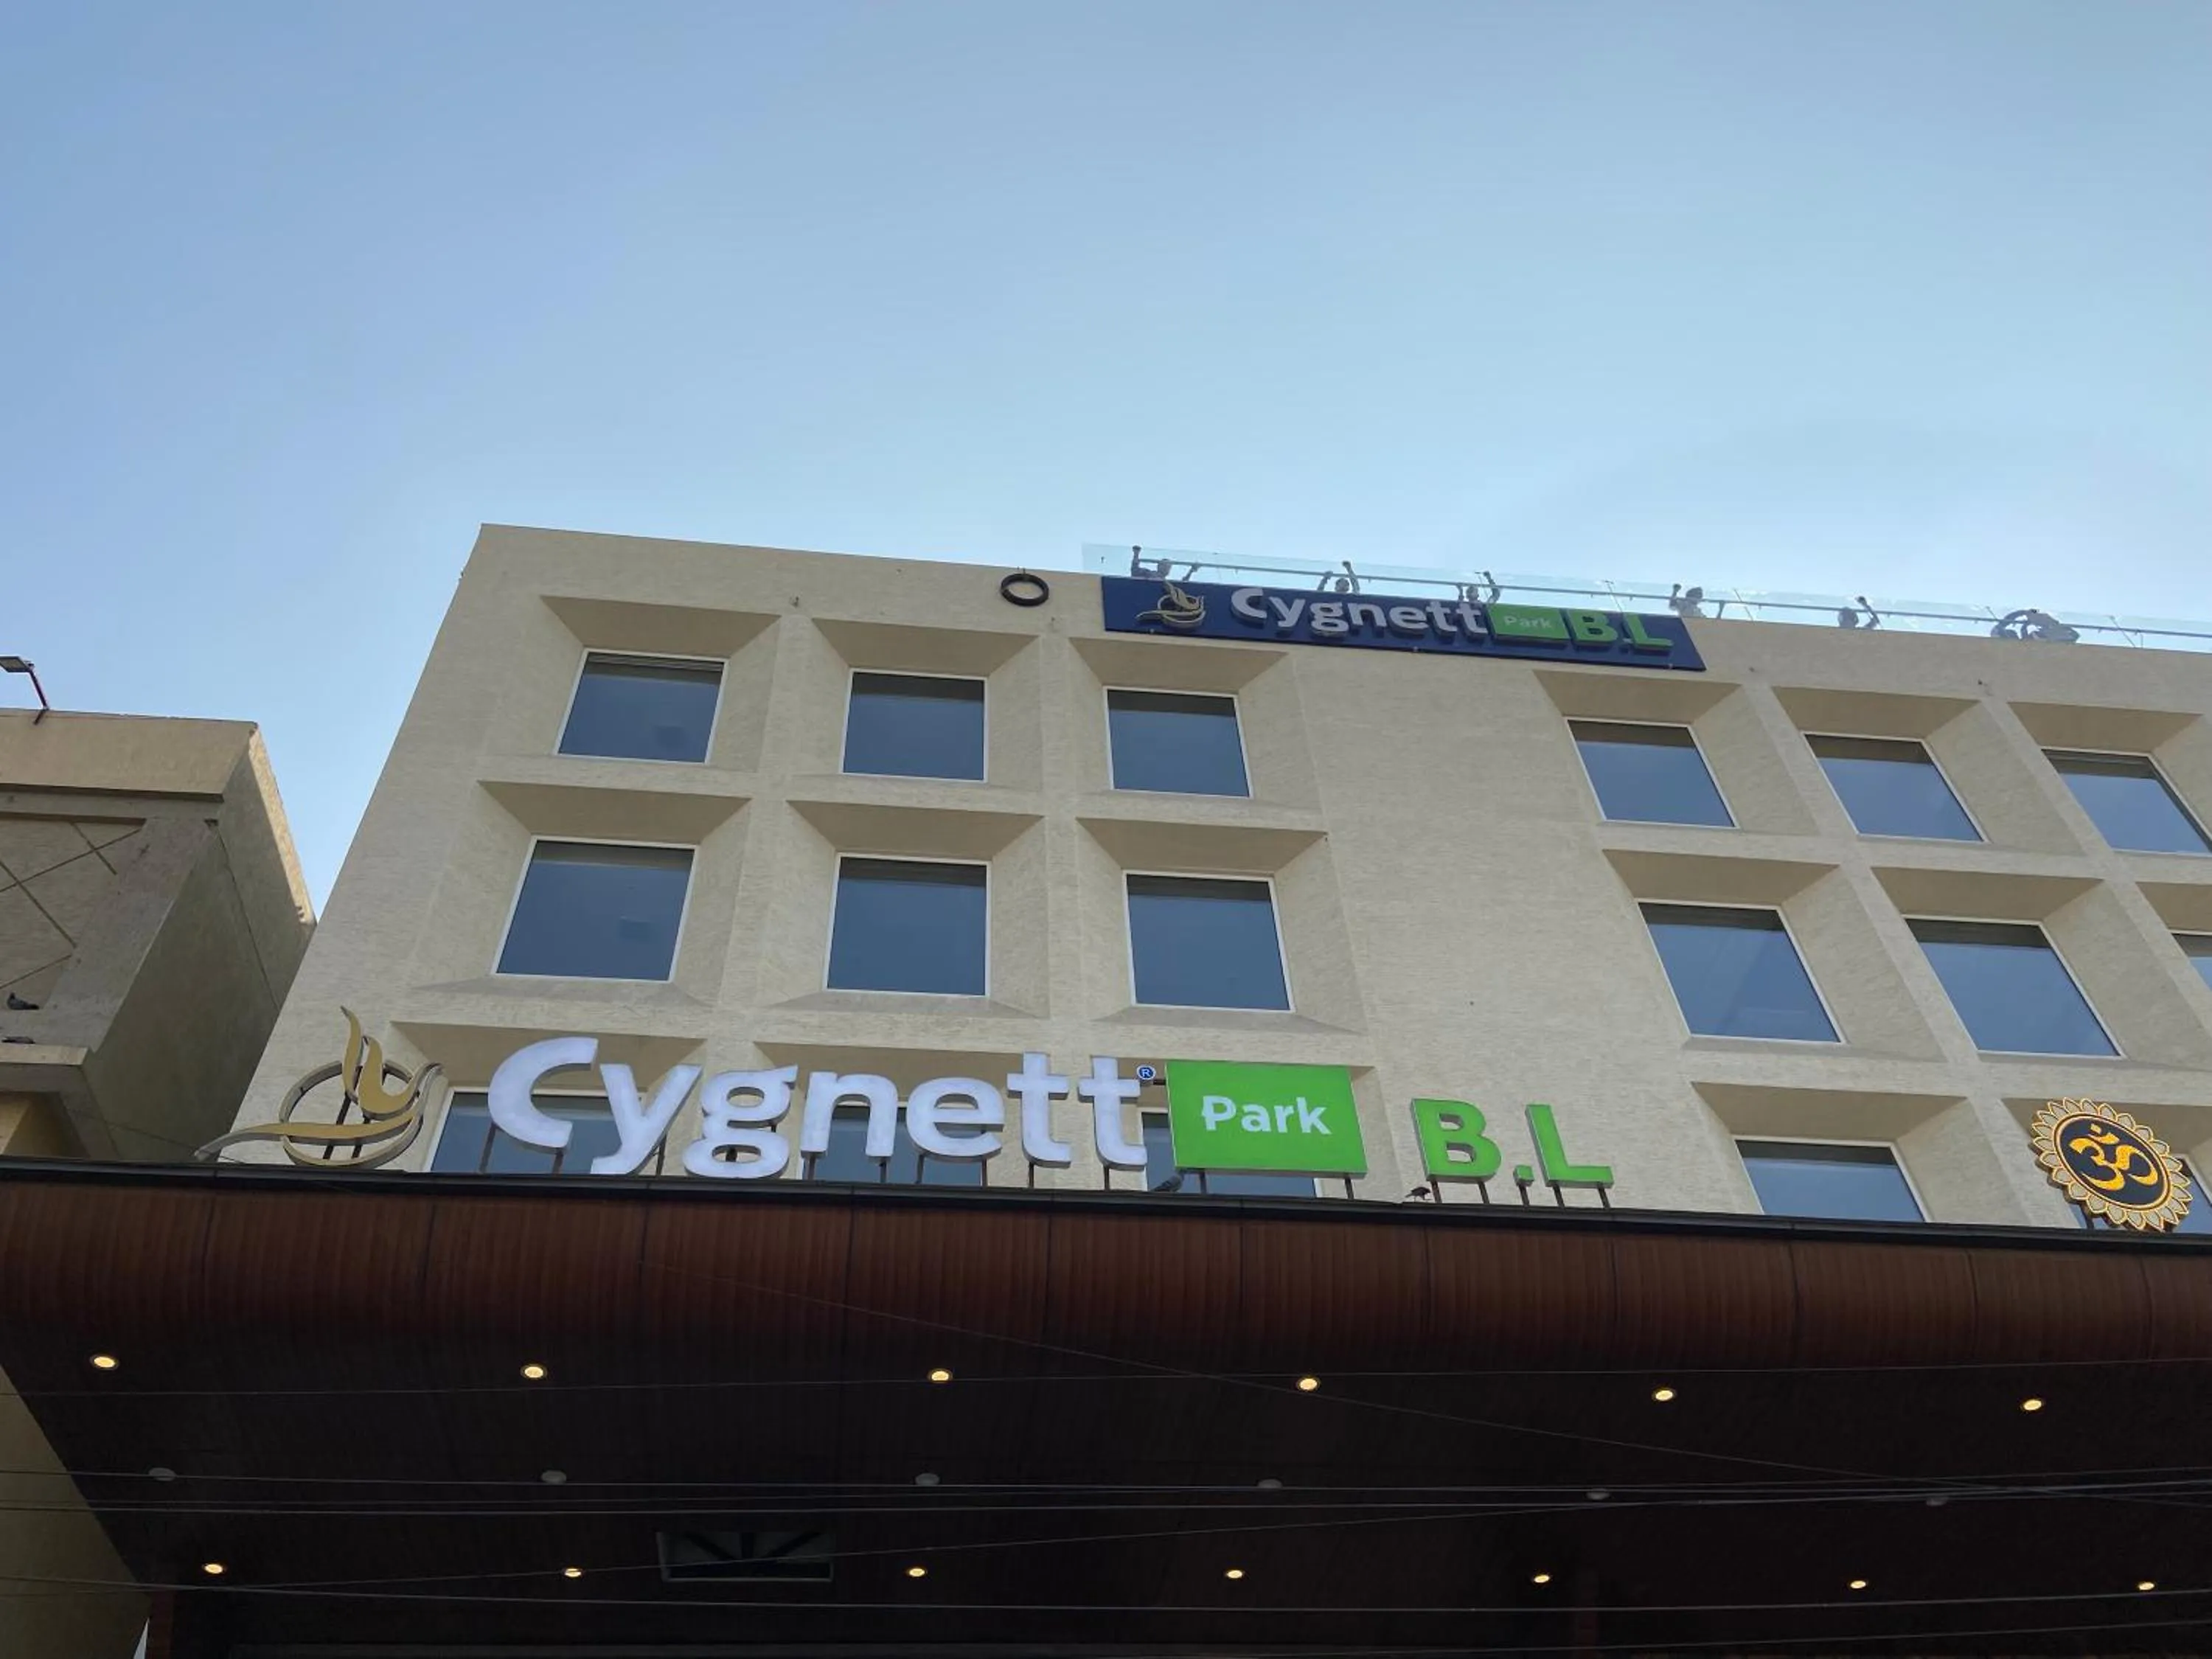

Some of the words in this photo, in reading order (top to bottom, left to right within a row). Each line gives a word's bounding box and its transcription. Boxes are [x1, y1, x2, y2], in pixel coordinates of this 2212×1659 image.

[1231, 588, 1487, 636] Cygnett
[1503, 614, 1553, 628] Park
[487, 1036, 1147, 1179] Cygnett
[1201, 1094, 1332, 1135] Park
[1410, 1097, 1615, 1189] B.L
